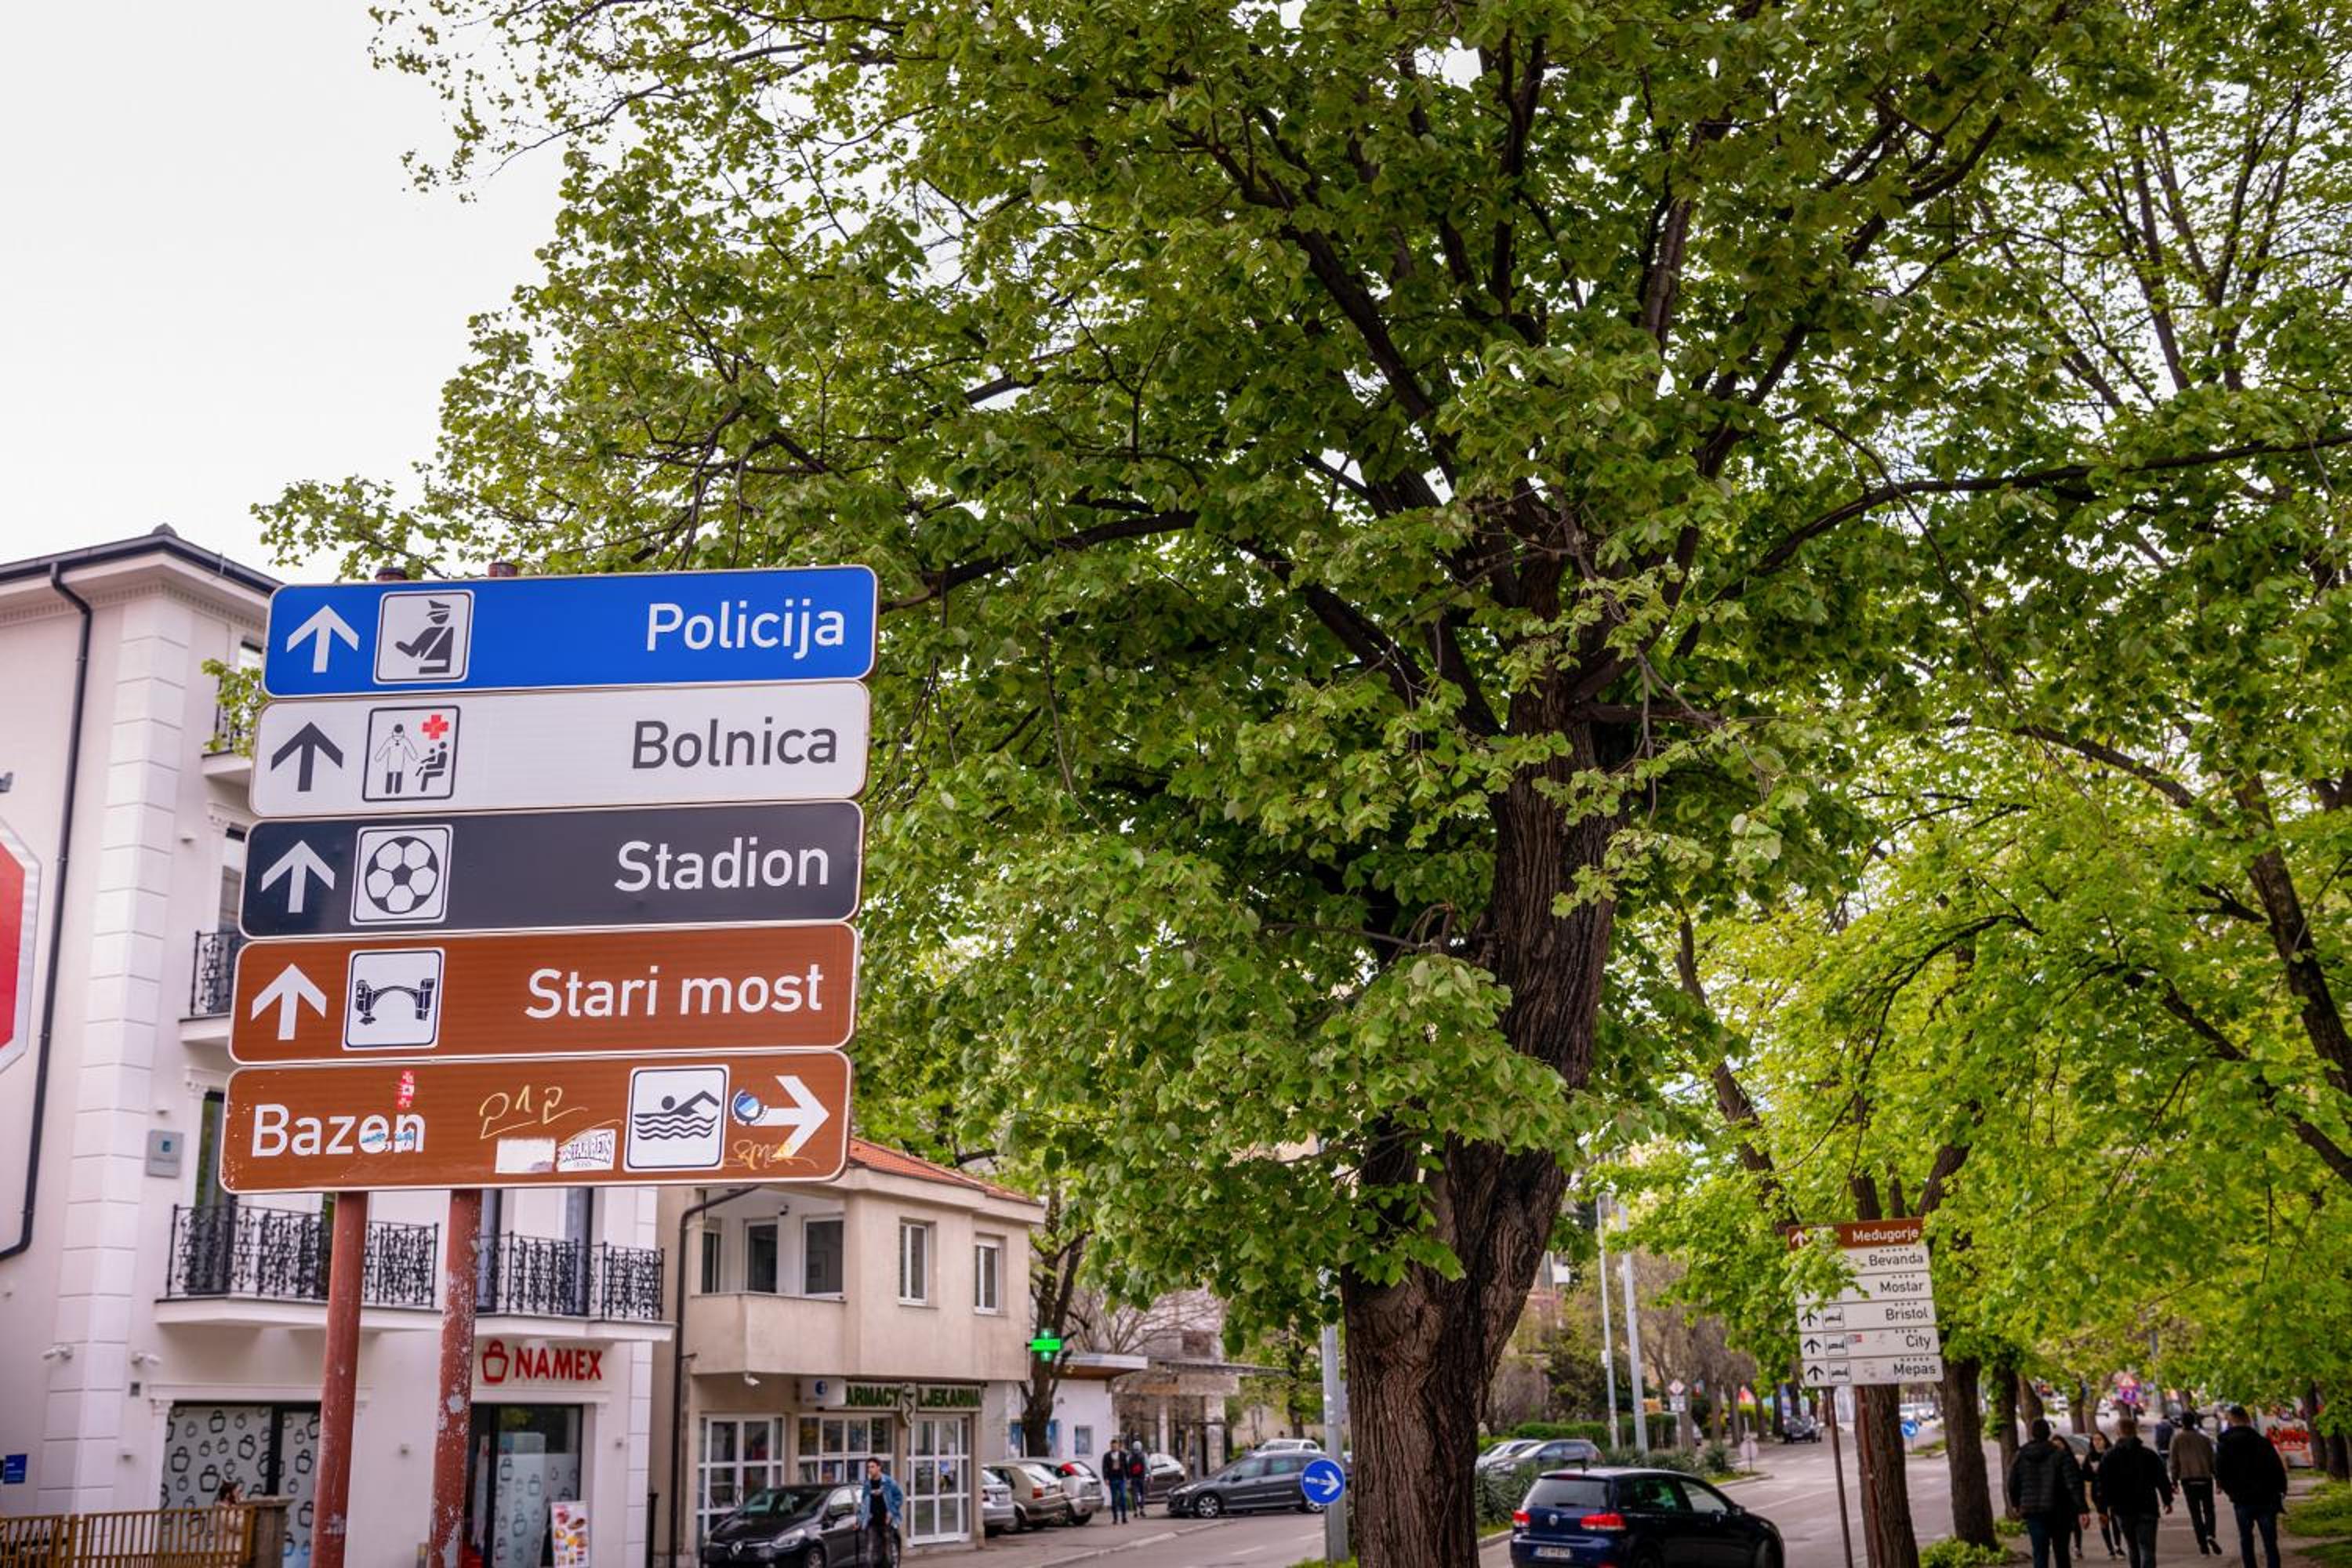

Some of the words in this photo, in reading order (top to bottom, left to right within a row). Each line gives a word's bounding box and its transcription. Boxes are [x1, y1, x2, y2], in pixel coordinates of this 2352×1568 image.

[646, 598, 844, 659] Policija
[632, 716, 837, 769] Bolnica
[614, 837, 829, 892] Stadion
[524, 965, 659, 1018] Stari
[680, 964, 824, 1014] most
[252, 1103, 426, 1157] Bazen
[1868, 1253, 1924, 1266] Bevanda
[1880, 1281, 1923, 1293] Mostar
[1886, 1307, 1928, 1321] Bristol
[1906, 1334, 1931, 1351] City
[514, 1347, 603, 1380] NAMEX
[1893, 1363, 1936, 1377] Mepas
[845, 1385, 901, 1406] ARMACY
